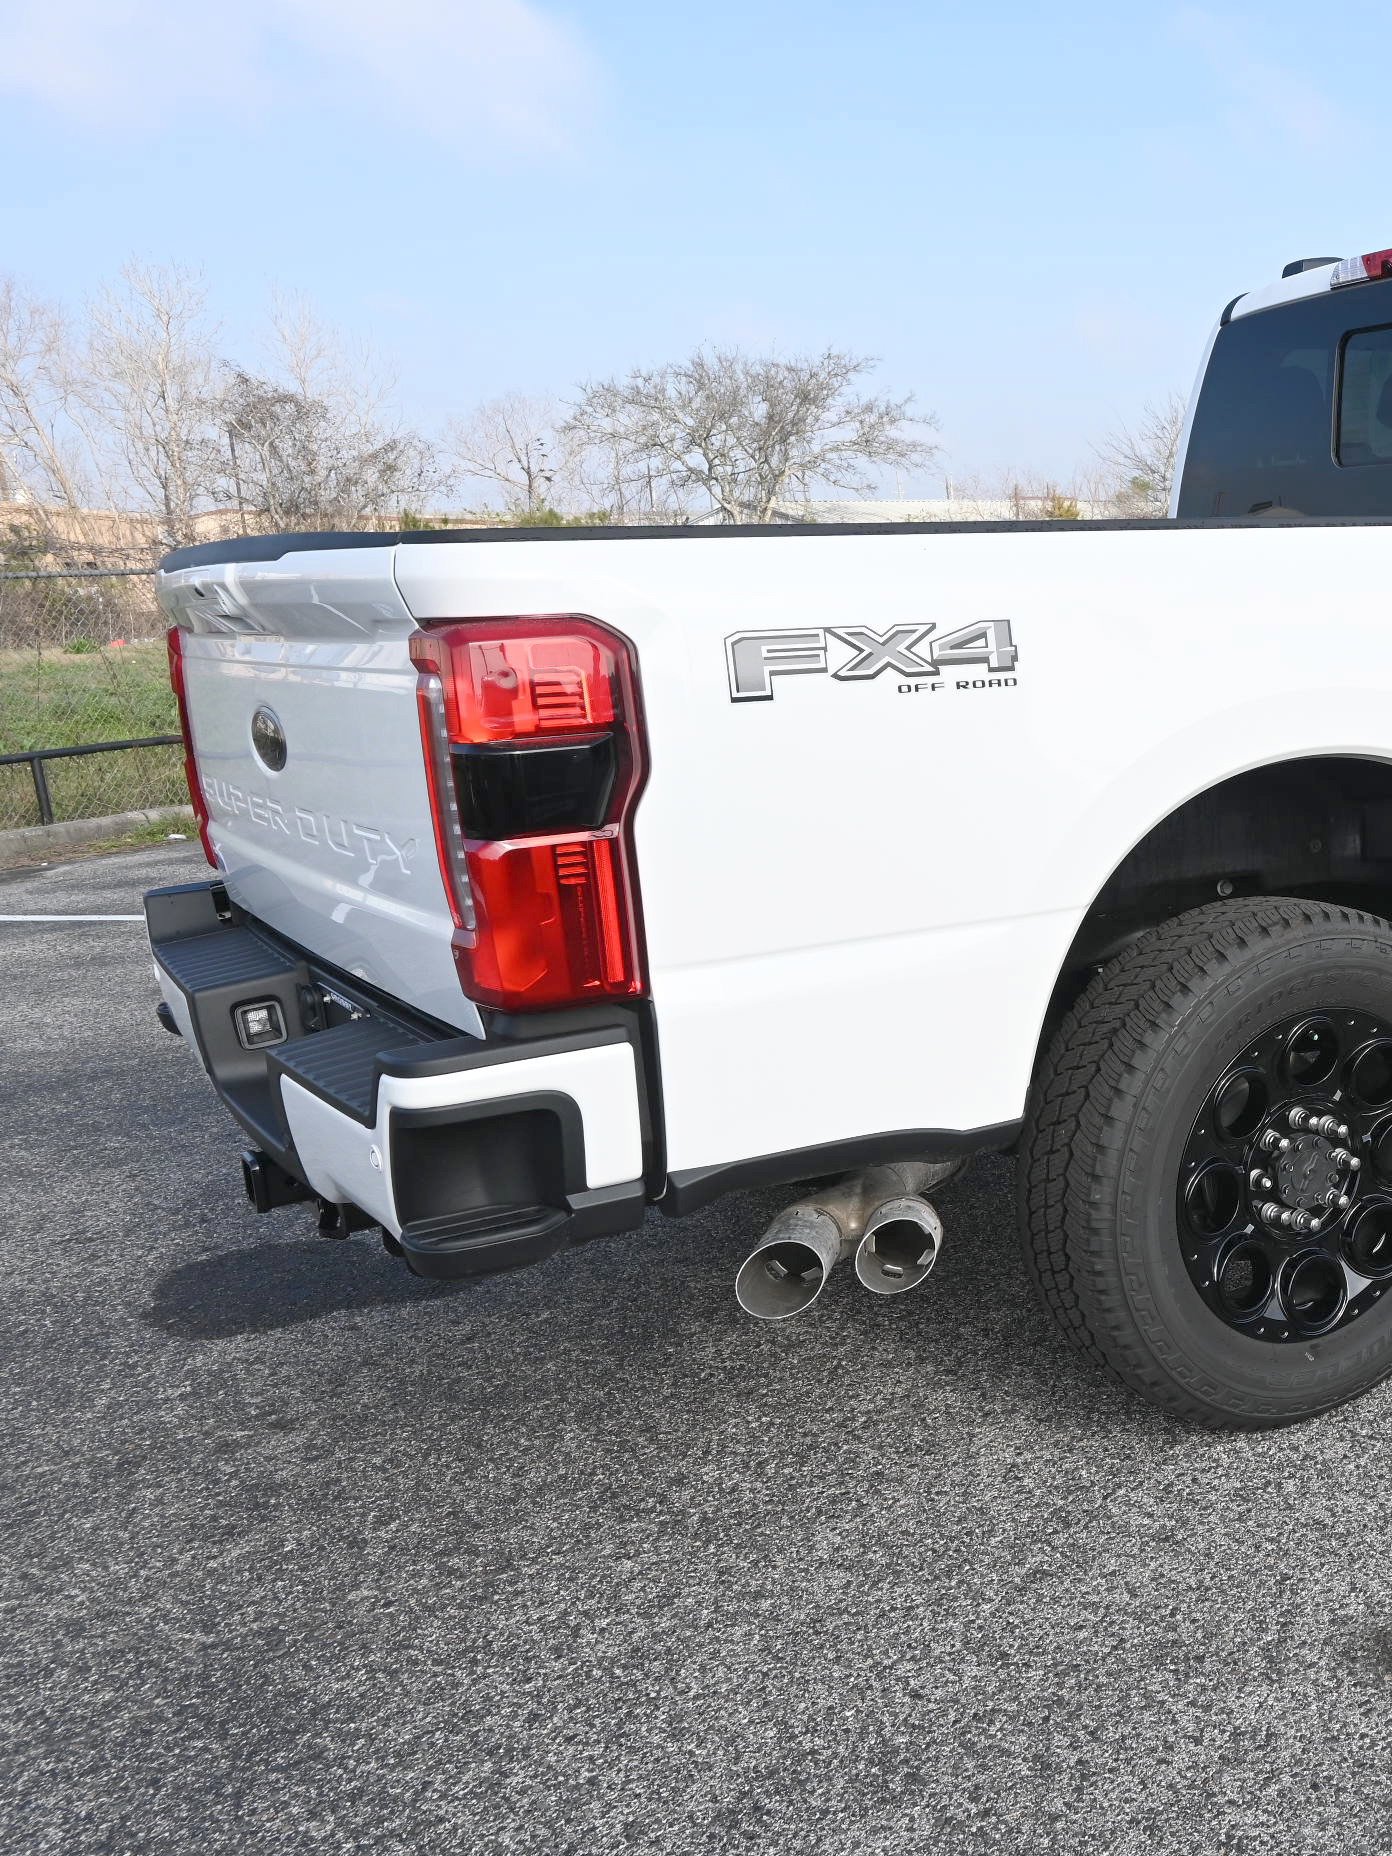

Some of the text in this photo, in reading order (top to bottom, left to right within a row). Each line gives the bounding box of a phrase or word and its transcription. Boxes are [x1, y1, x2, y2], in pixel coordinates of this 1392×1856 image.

[724, 619, 1018, 703] FX4
[897, 676, 1018, 694] OFF ROAD
[201, 774, 419, 876] SUPER DUTY
